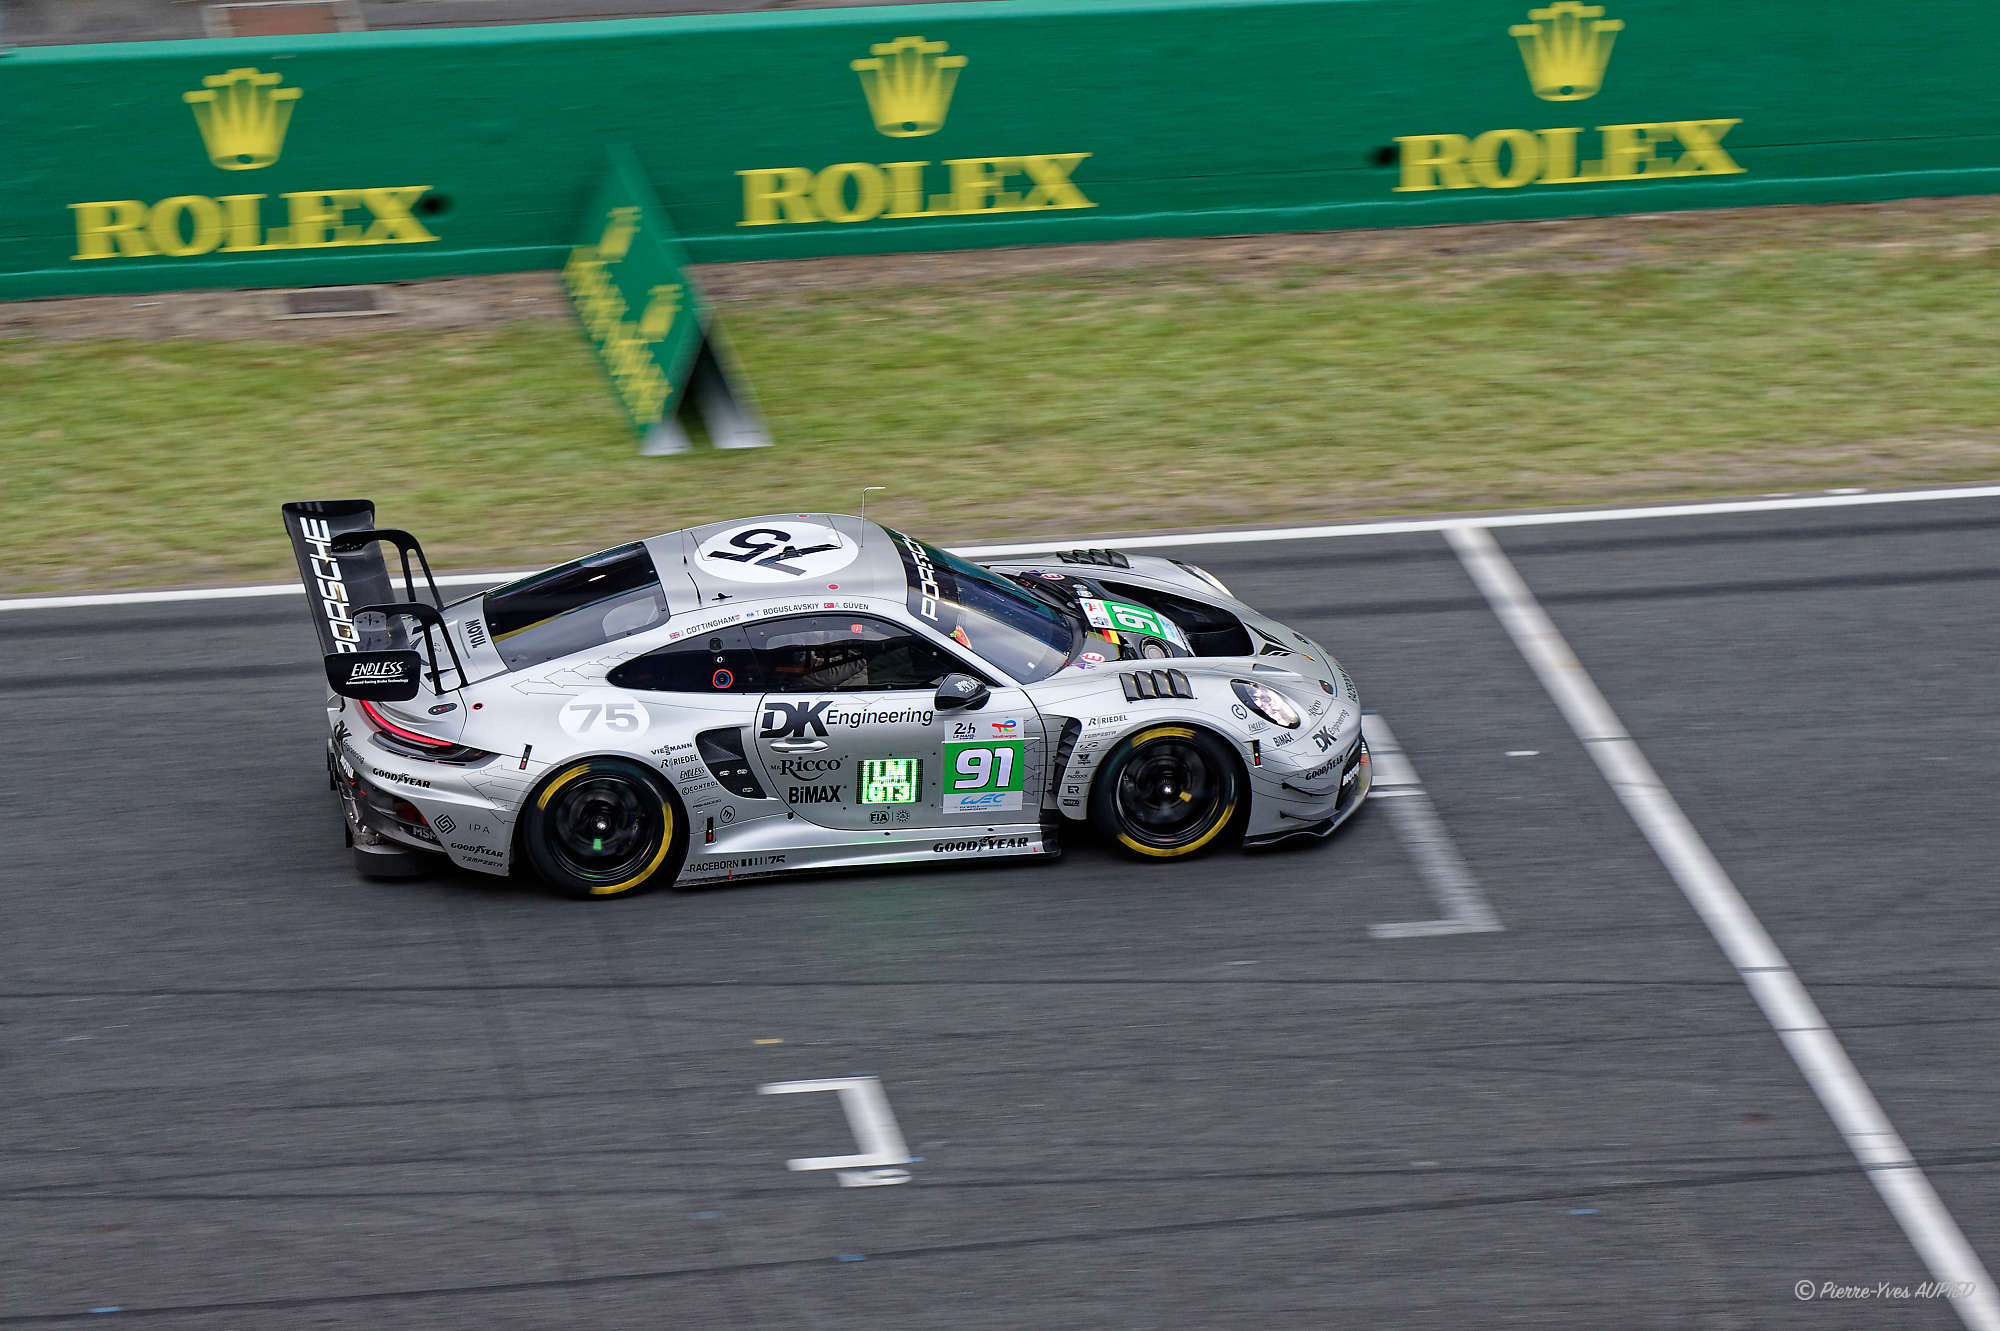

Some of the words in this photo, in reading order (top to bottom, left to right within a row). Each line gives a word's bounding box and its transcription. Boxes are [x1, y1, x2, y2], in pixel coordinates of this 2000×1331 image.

[1392, 119, 1747, 192] ROLEX
[734, 152, 1098, 226] ROLEX
[67, 185, 441, 260] ROLEX
[708, 528, 842, 576] 75
[763, 602, 819, 616] BOGUSLAVSKIY
[1111, 605, 1161, 634] 91
[465, 618, 487, 649] MOTUL
[686, 615, 735, 635] COTTINGHAM
[351, 661, 404, 677] ENDLESS
[569, 703, 639, 733] 75
[760, 701, 834, 739] DK
[826, 708, 934, 729] Engineering
[1102, 714, 1128, 724] RIEDEL
[1312, 725, 1337, 752] DK
[674, 754, 699, 766] RIEDEL
[954, 747, 1015, 790] 91
[372, 767, 431, 789] GOODYEAR
[789, 785, 842, 804] BiMAX
[451, 842, 503, 858] GOODYEAR
[933, 836, 1029, 853] GOODYEAR
[690, 860, 738, 872] RACEBORN
